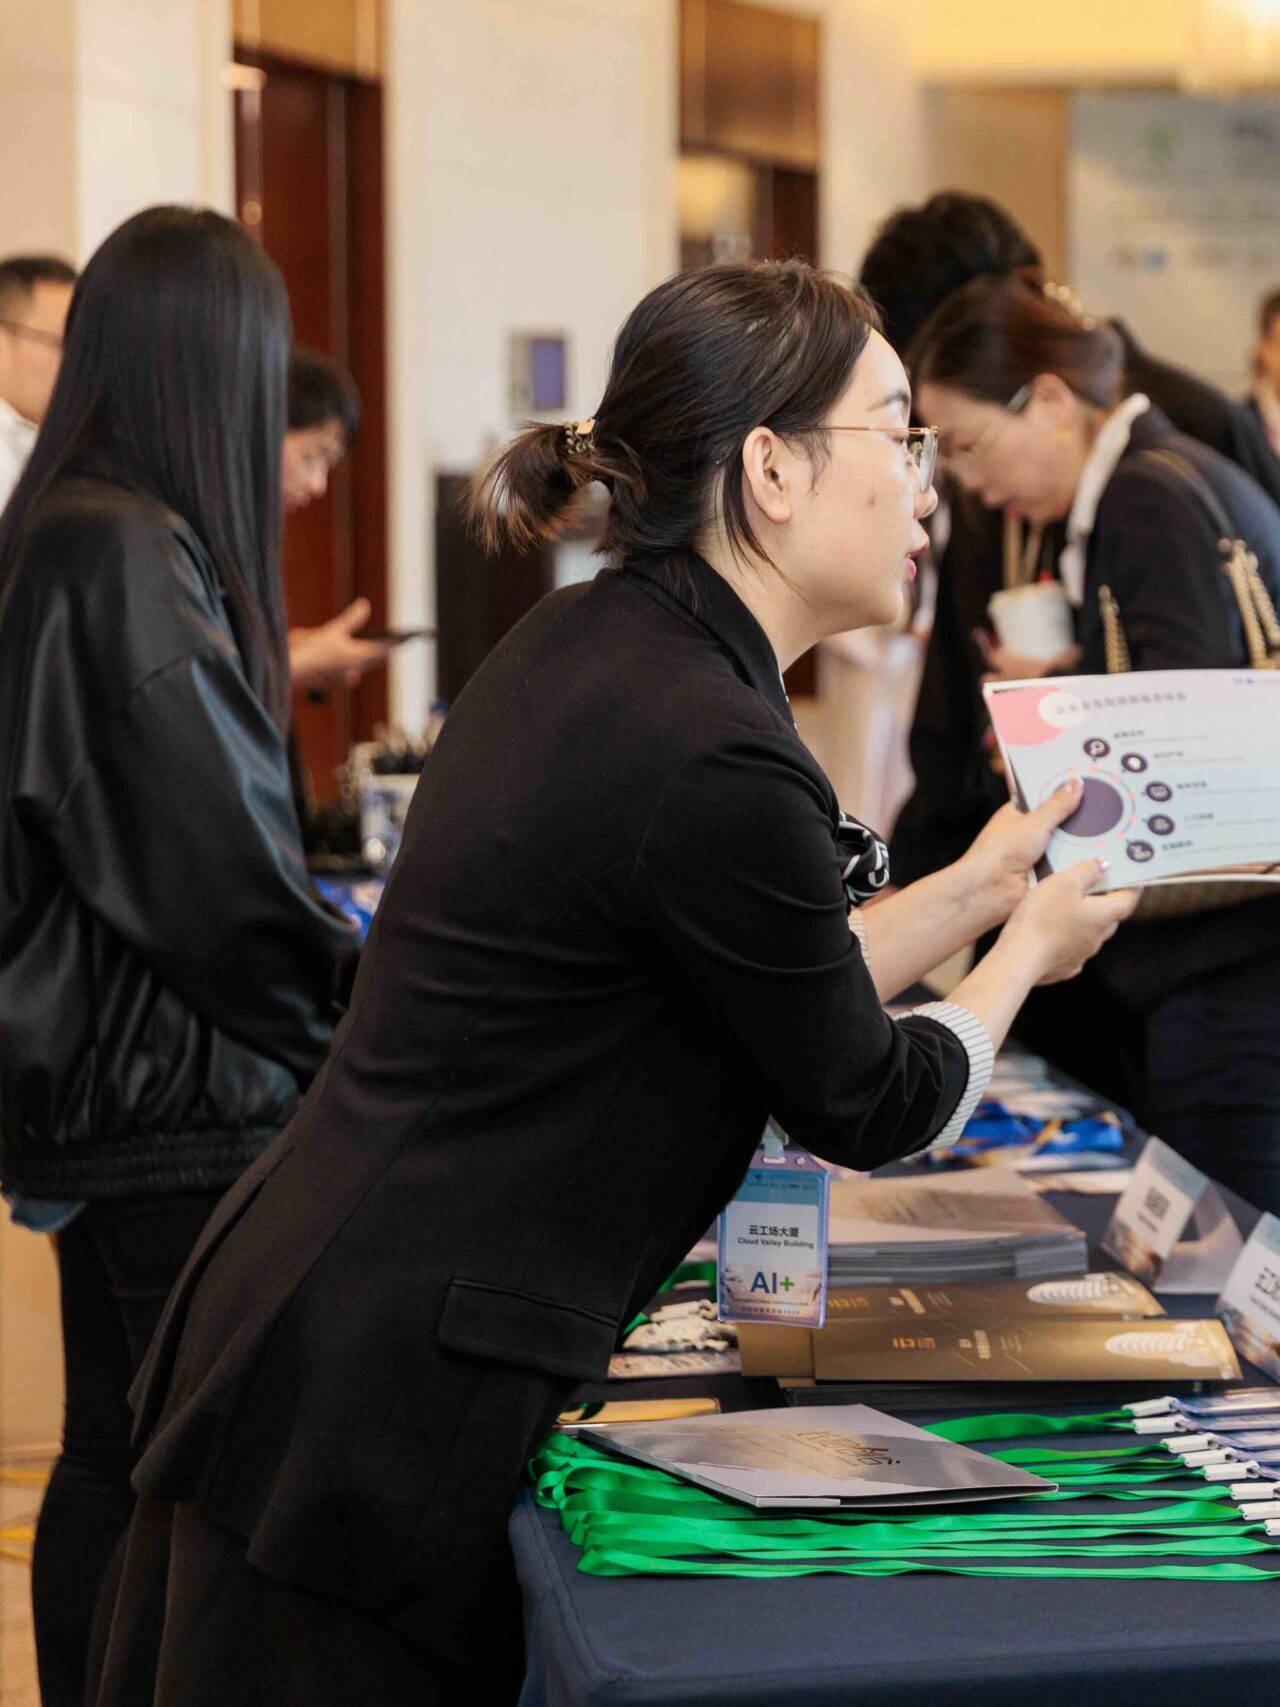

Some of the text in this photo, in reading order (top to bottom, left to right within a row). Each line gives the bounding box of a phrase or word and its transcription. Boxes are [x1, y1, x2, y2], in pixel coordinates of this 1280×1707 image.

[749, 1224, 799, 1238] 云工场大厦
[737, 1237, 814, 1250] Cloud Valley Building
[750, 1271, 795, 1294] AI+
